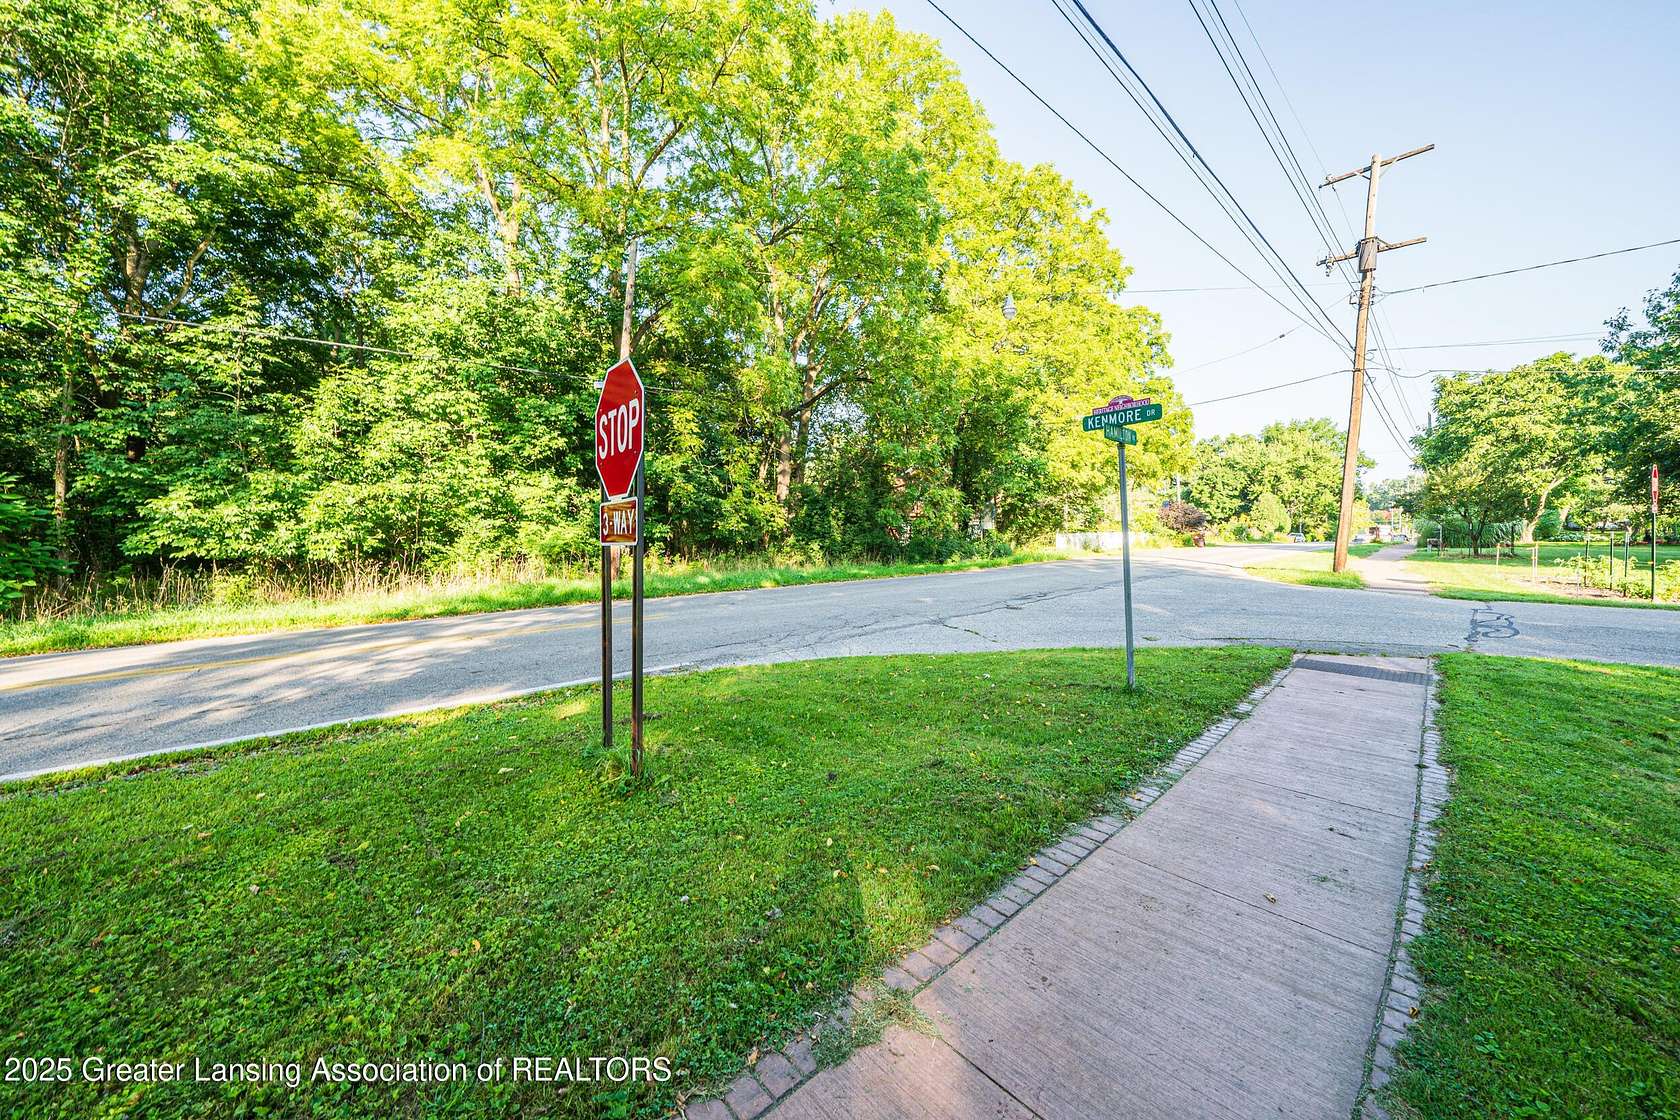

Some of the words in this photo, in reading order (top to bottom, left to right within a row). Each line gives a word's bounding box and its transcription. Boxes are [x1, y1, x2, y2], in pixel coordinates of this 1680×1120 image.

[598, 398, 639, 460] STOP
[1087, 409, 1141, 429] KENMORE
[1146, 409, 1156, 417] DR
[602, 508, 635, 536] 3-WAY
